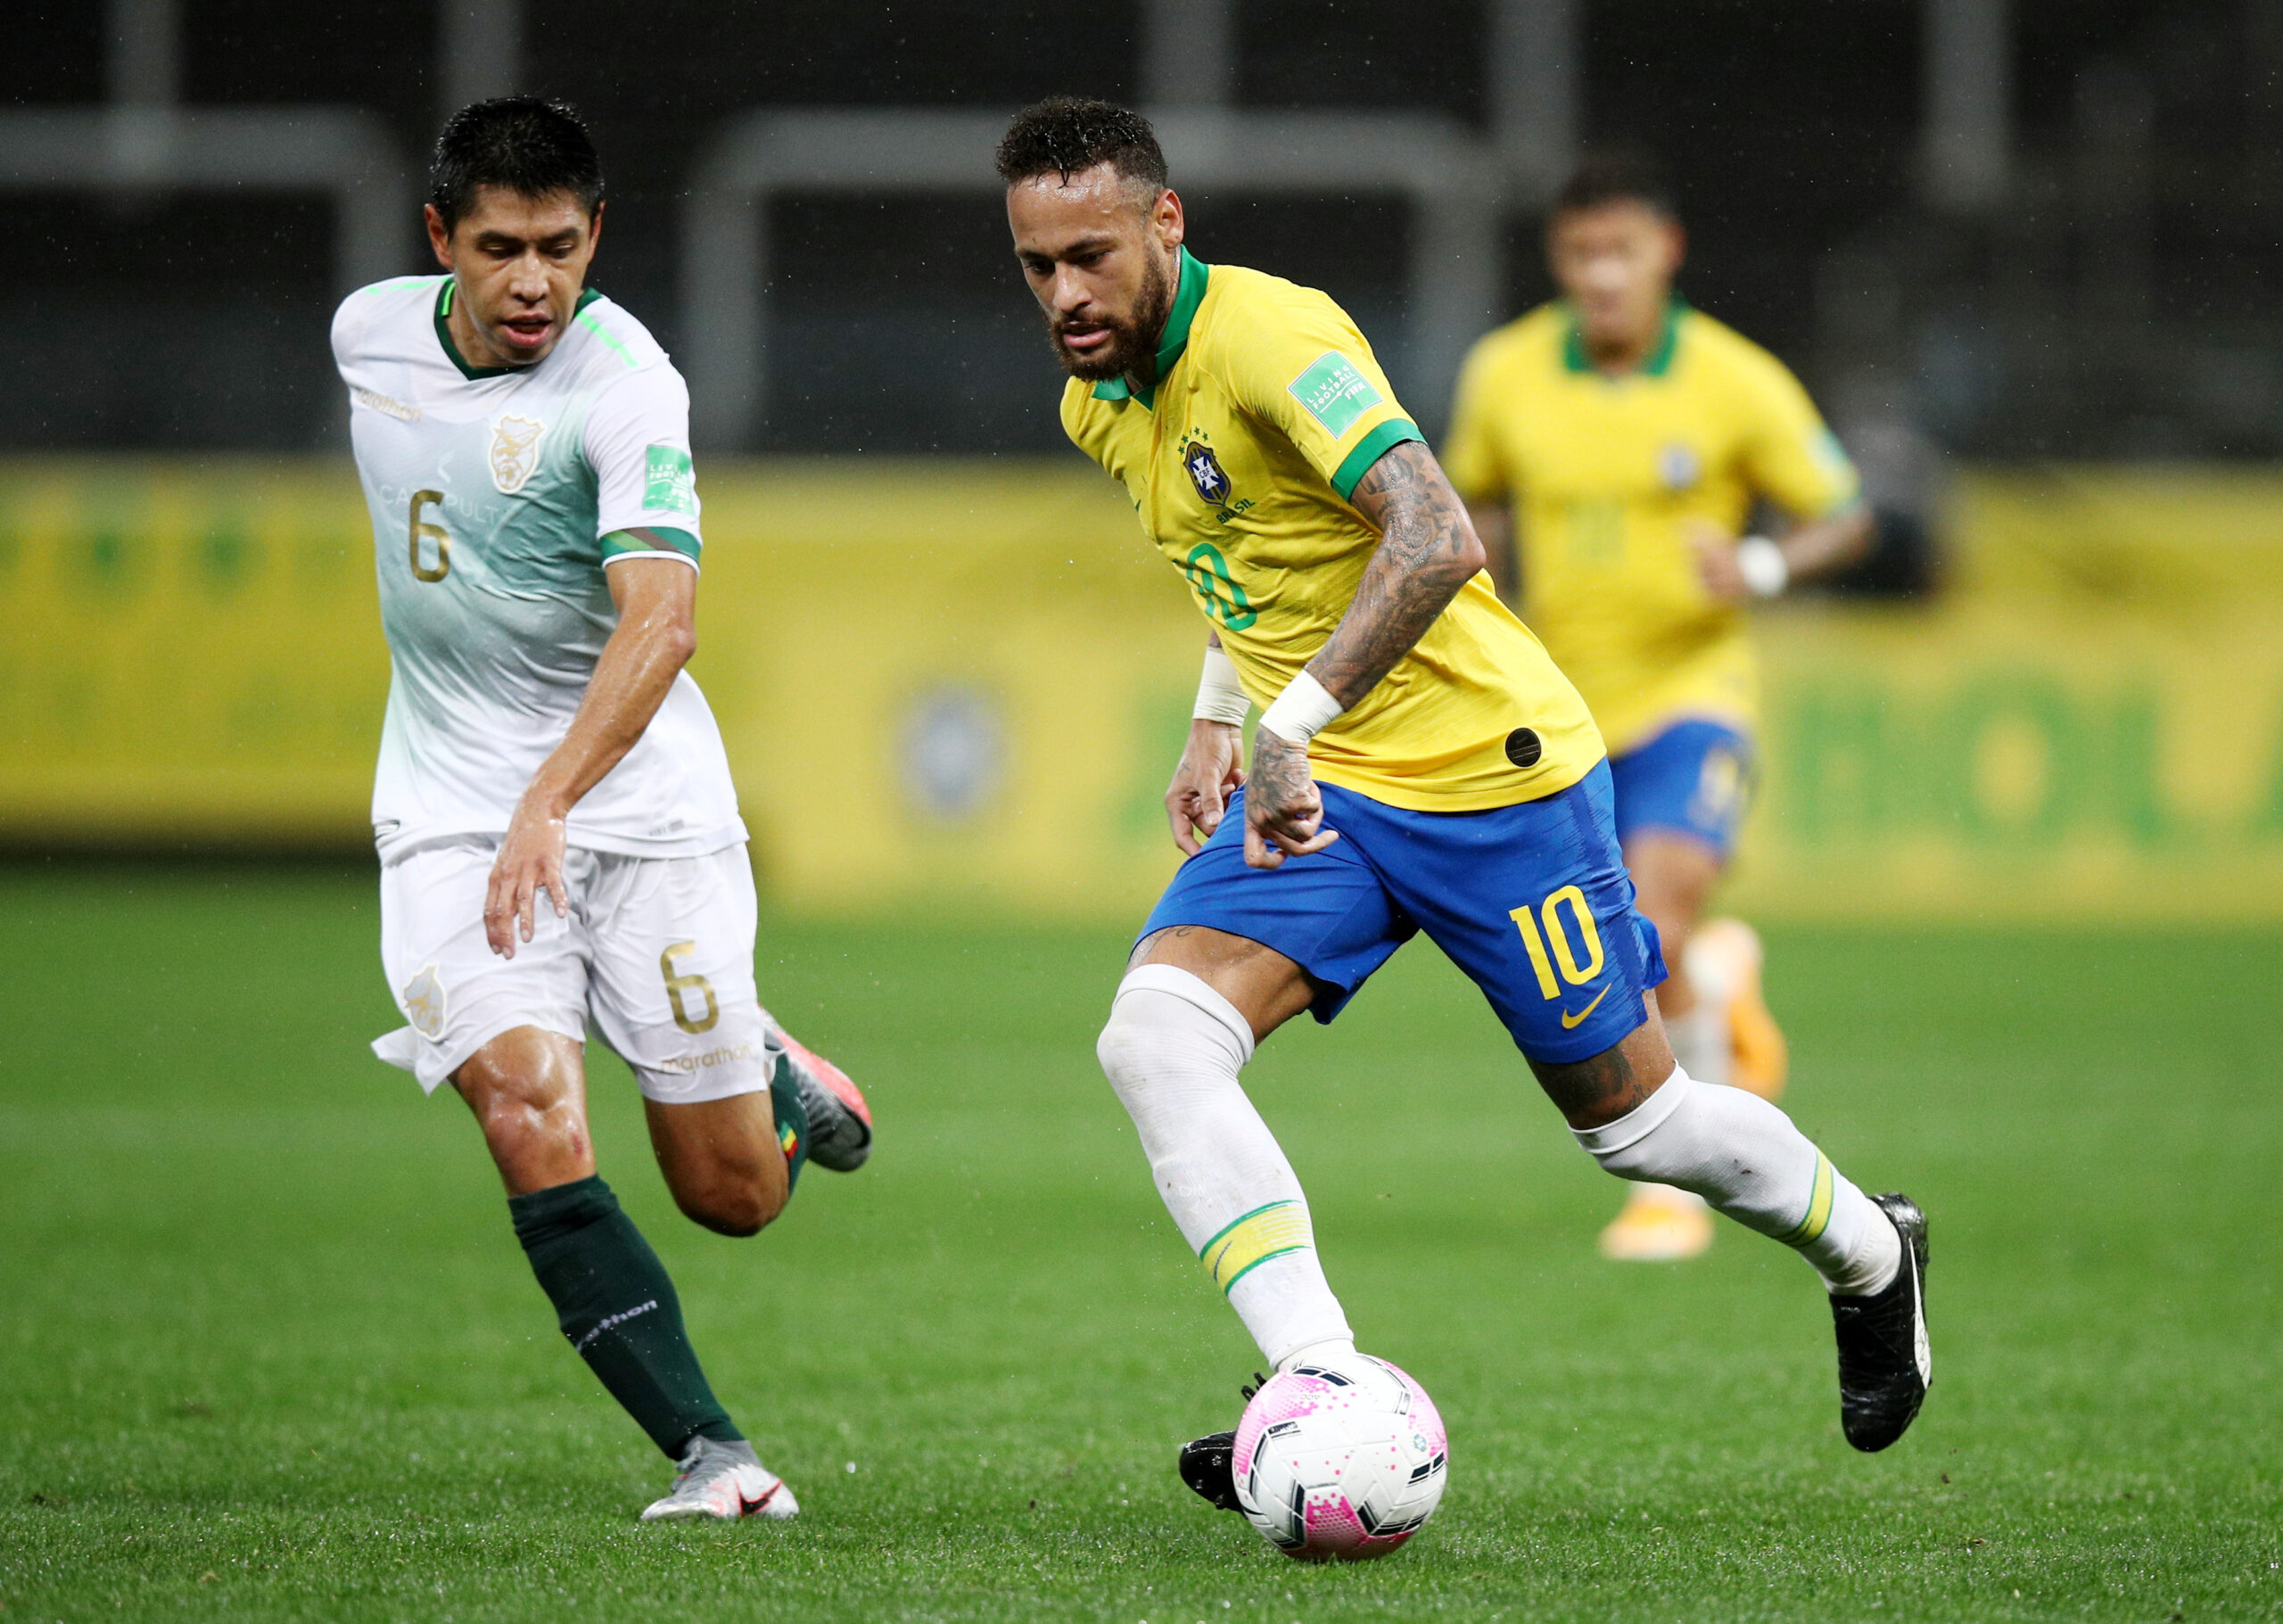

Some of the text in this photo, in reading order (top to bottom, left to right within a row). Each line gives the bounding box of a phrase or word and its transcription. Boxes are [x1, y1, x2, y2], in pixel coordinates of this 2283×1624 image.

[1306, 365, 1351, 404] LIVING
[1312, 370, 1356, 410] FOOTBALL
[1344, 381, 1367, 400] FIFA
[1199, 467, 1211, 479] CBF
[1216, 498, 1257, 524] BRASIL
[409, 489, 450, 583] 6
[1508, 885, 1604, 1000] 10
[660, 941, 720, 1035] 6
[662, 1044, 752, 1072] marathon
